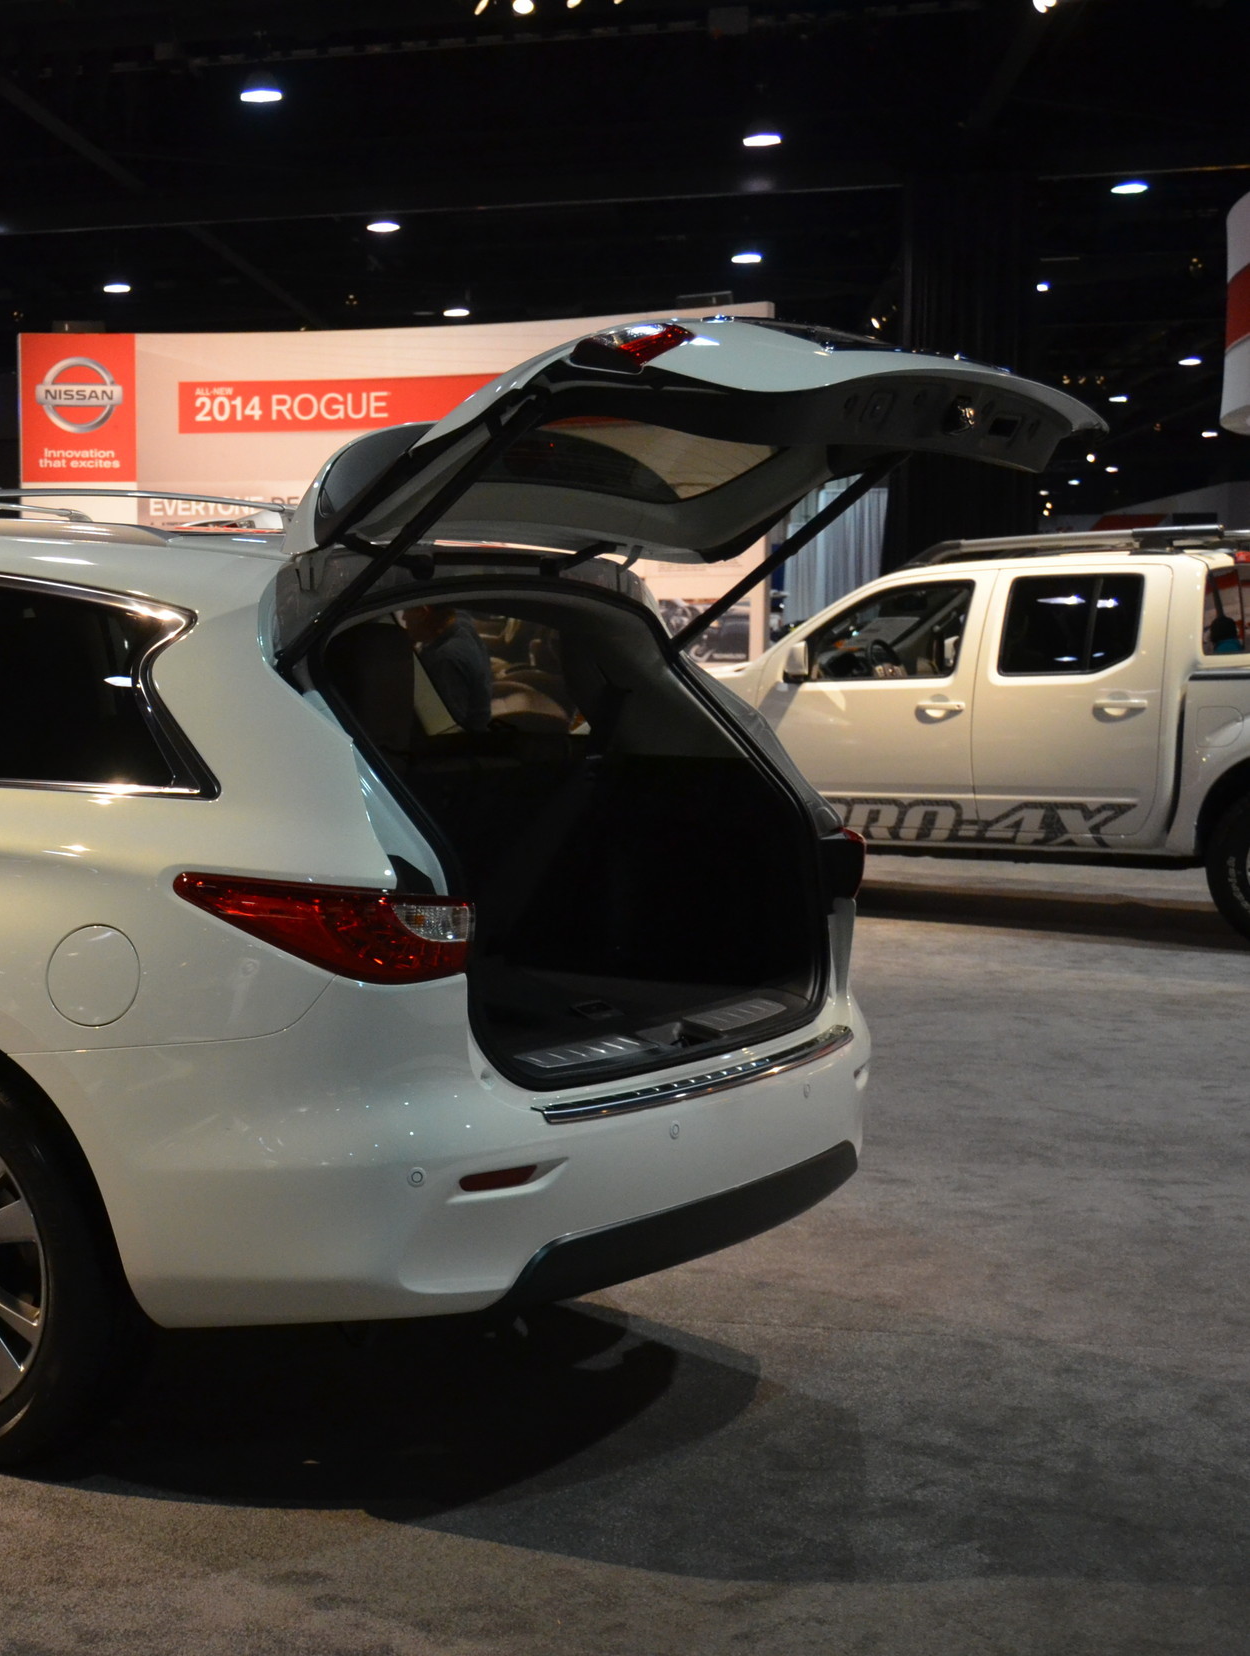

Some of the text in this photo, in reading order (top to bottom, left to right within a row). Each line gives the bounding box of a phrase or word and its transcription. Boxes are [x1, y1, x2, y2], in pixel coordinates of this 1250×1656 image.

[44, 389, 114, 401] NISSAN
[195, 387, 233, 396] ALL-NEW
[194, 392, 390, 422] 2014 ROGUE
[43, 448, 116, 459] Innovation
[38, 458, 121, 469] that excites
